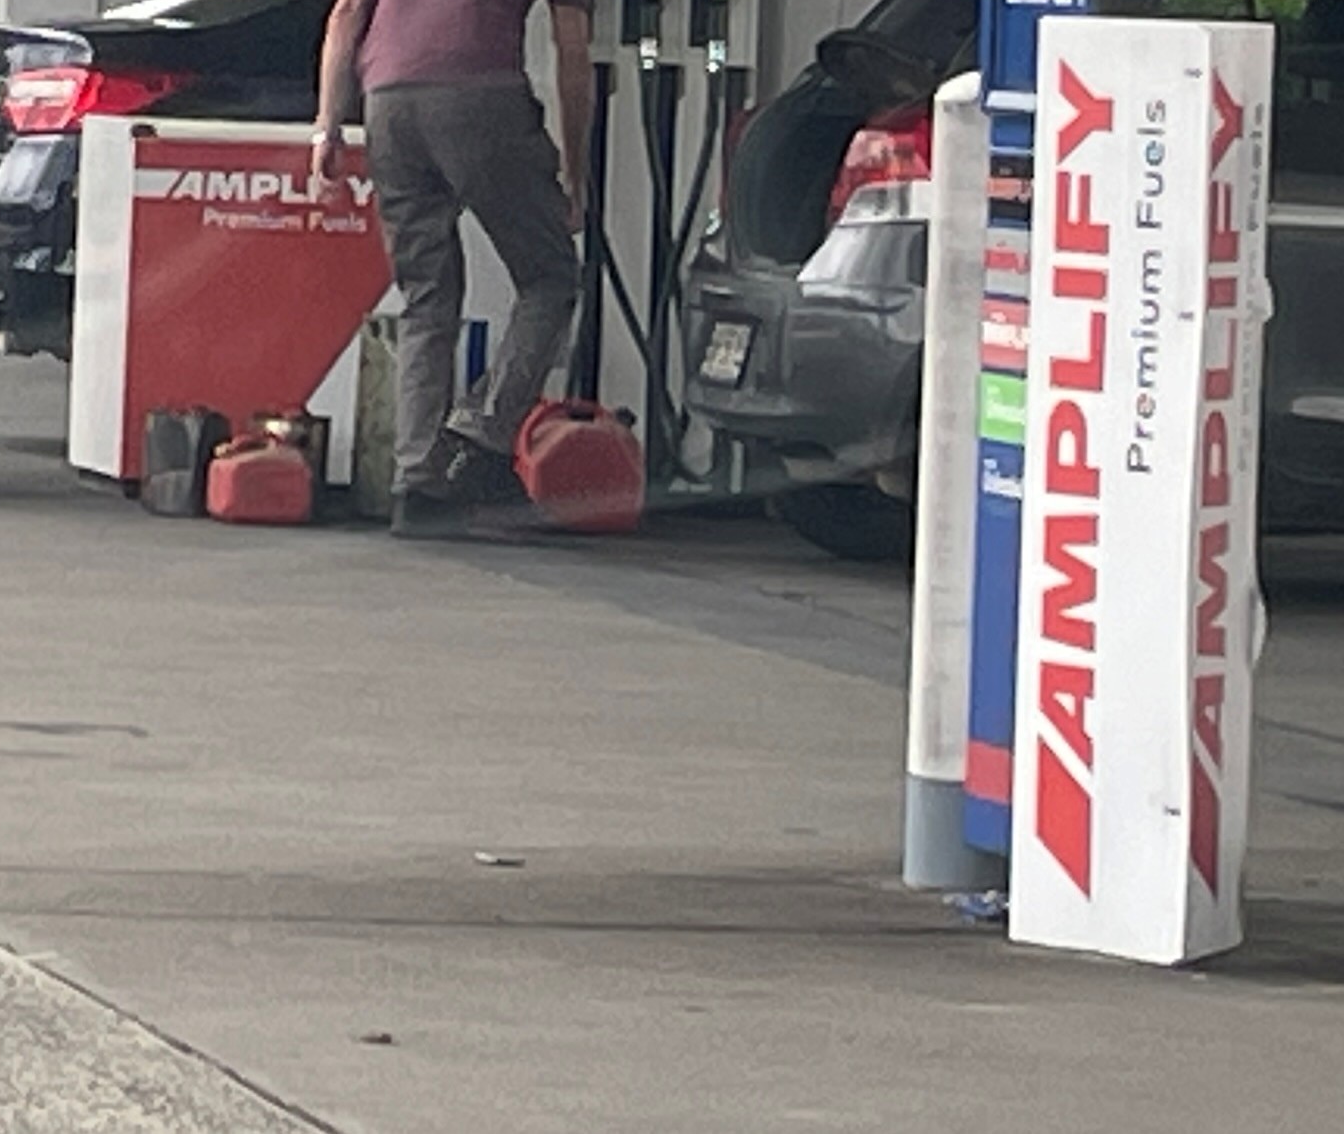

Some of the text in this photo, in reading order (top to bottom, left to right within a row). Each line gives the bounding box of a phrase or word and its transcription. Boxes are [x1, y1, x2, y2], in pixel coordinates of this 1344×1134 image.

[170, 170, 374, 206] AMPLIY
[202, 206, 368, 233] Premium Fuels
[1127, 99, 1167, 474] Premium Fuels
[1037, 57, 1114, 773] AMPLIFY
[1192, 69, 1244, 775] AMPLIFY
